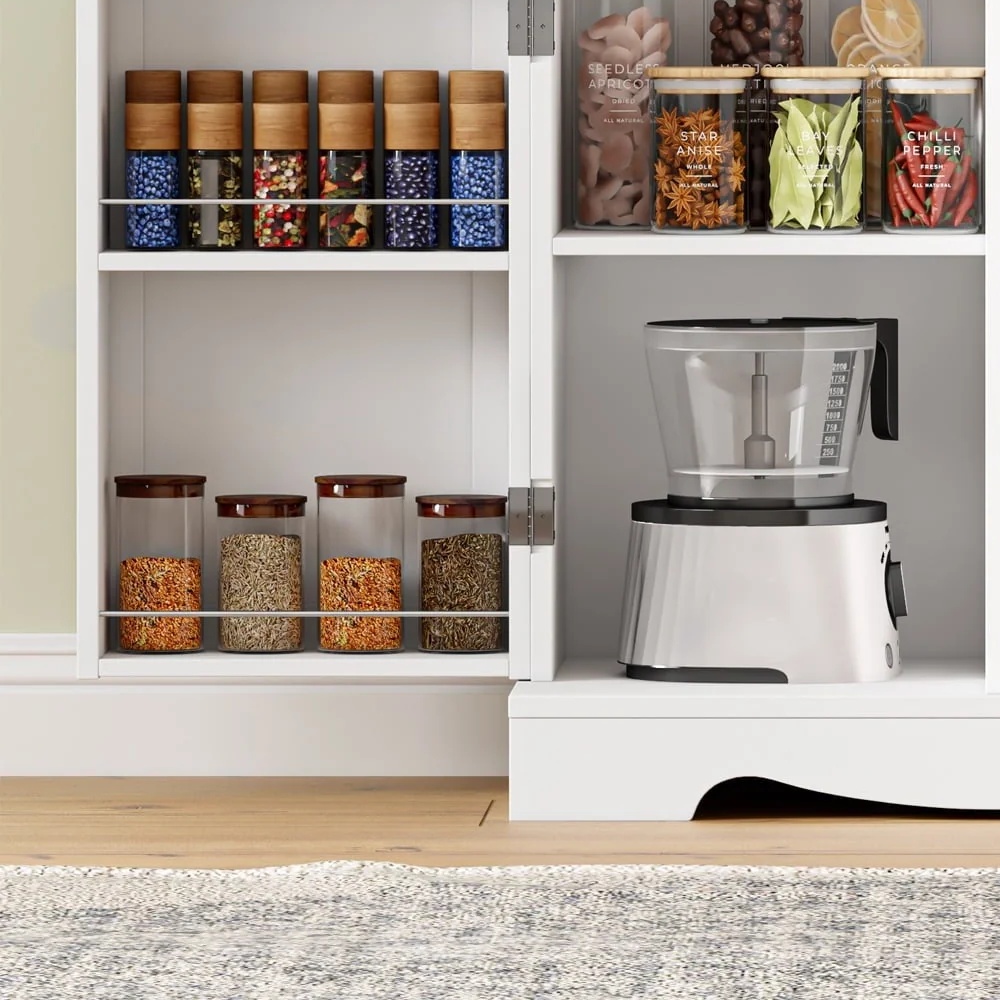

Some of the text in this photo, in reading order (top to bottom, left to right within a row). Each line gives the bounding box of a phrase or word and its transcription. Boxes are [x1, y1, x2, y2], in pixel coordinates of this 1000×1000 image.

[680, 131, 718, 142] STAR
[907, 131, 956, 142] CHILLI
[676, 146, 722, 156] ANISE
[903, 146, 961, 156] PEPPER
